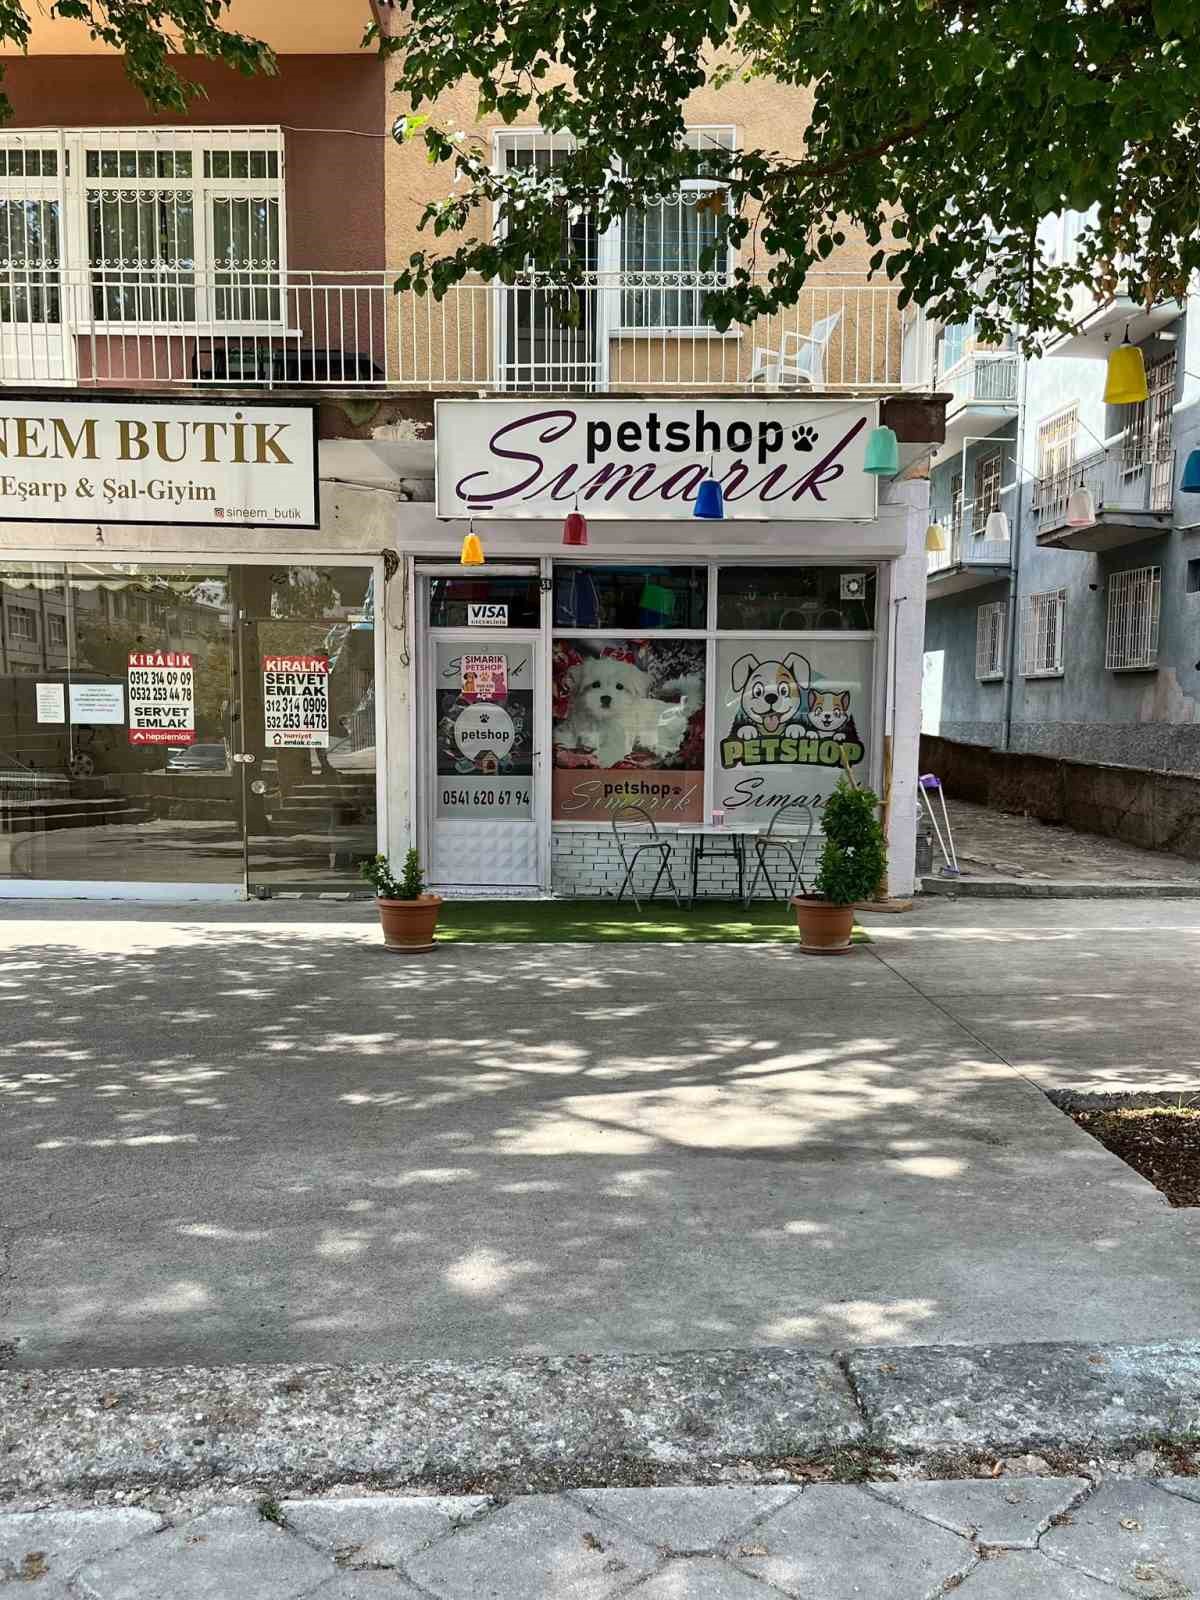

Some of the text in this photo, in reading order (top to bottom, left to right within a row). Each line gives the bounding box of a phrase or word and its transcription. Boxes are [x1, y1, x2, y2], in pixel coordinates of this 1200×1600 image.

[115, 411, 294, 465] BUTİK
[587, 410, 784, 464] petshop
[0, 475, 217, 505] Eşarp & Şal-Giyim
[226, 508, 302, 521] sineem_butik
[472, 606, 506, 618] VISA
[465, 655, 503, 664] SIMARIK
[130, 671, 191, 685] 0312 314 09 09
[266, 673, 326, 685] SERVET
[130, 687, 151, 701] 0532
[153, 687, 167, 701] 253
[169, 687, 180, 701] 44
[181, 687, 192, 701] 78
[266, 686, 325, 696] EMLAK
[134, 707, 189, 717] SERVET
[266, 697, 327, 713] 312 314 0909
[137, 719, 186, 728] EMLAK
[267, 714, 327, 729] 532 253 4478
[461, 727, 510, 743] petshop
[722, 738, 863, 767] PETSHOP
[604, 781, 670, 798] petshop
[443, 790, 530, 806] 0541 620 67 94
